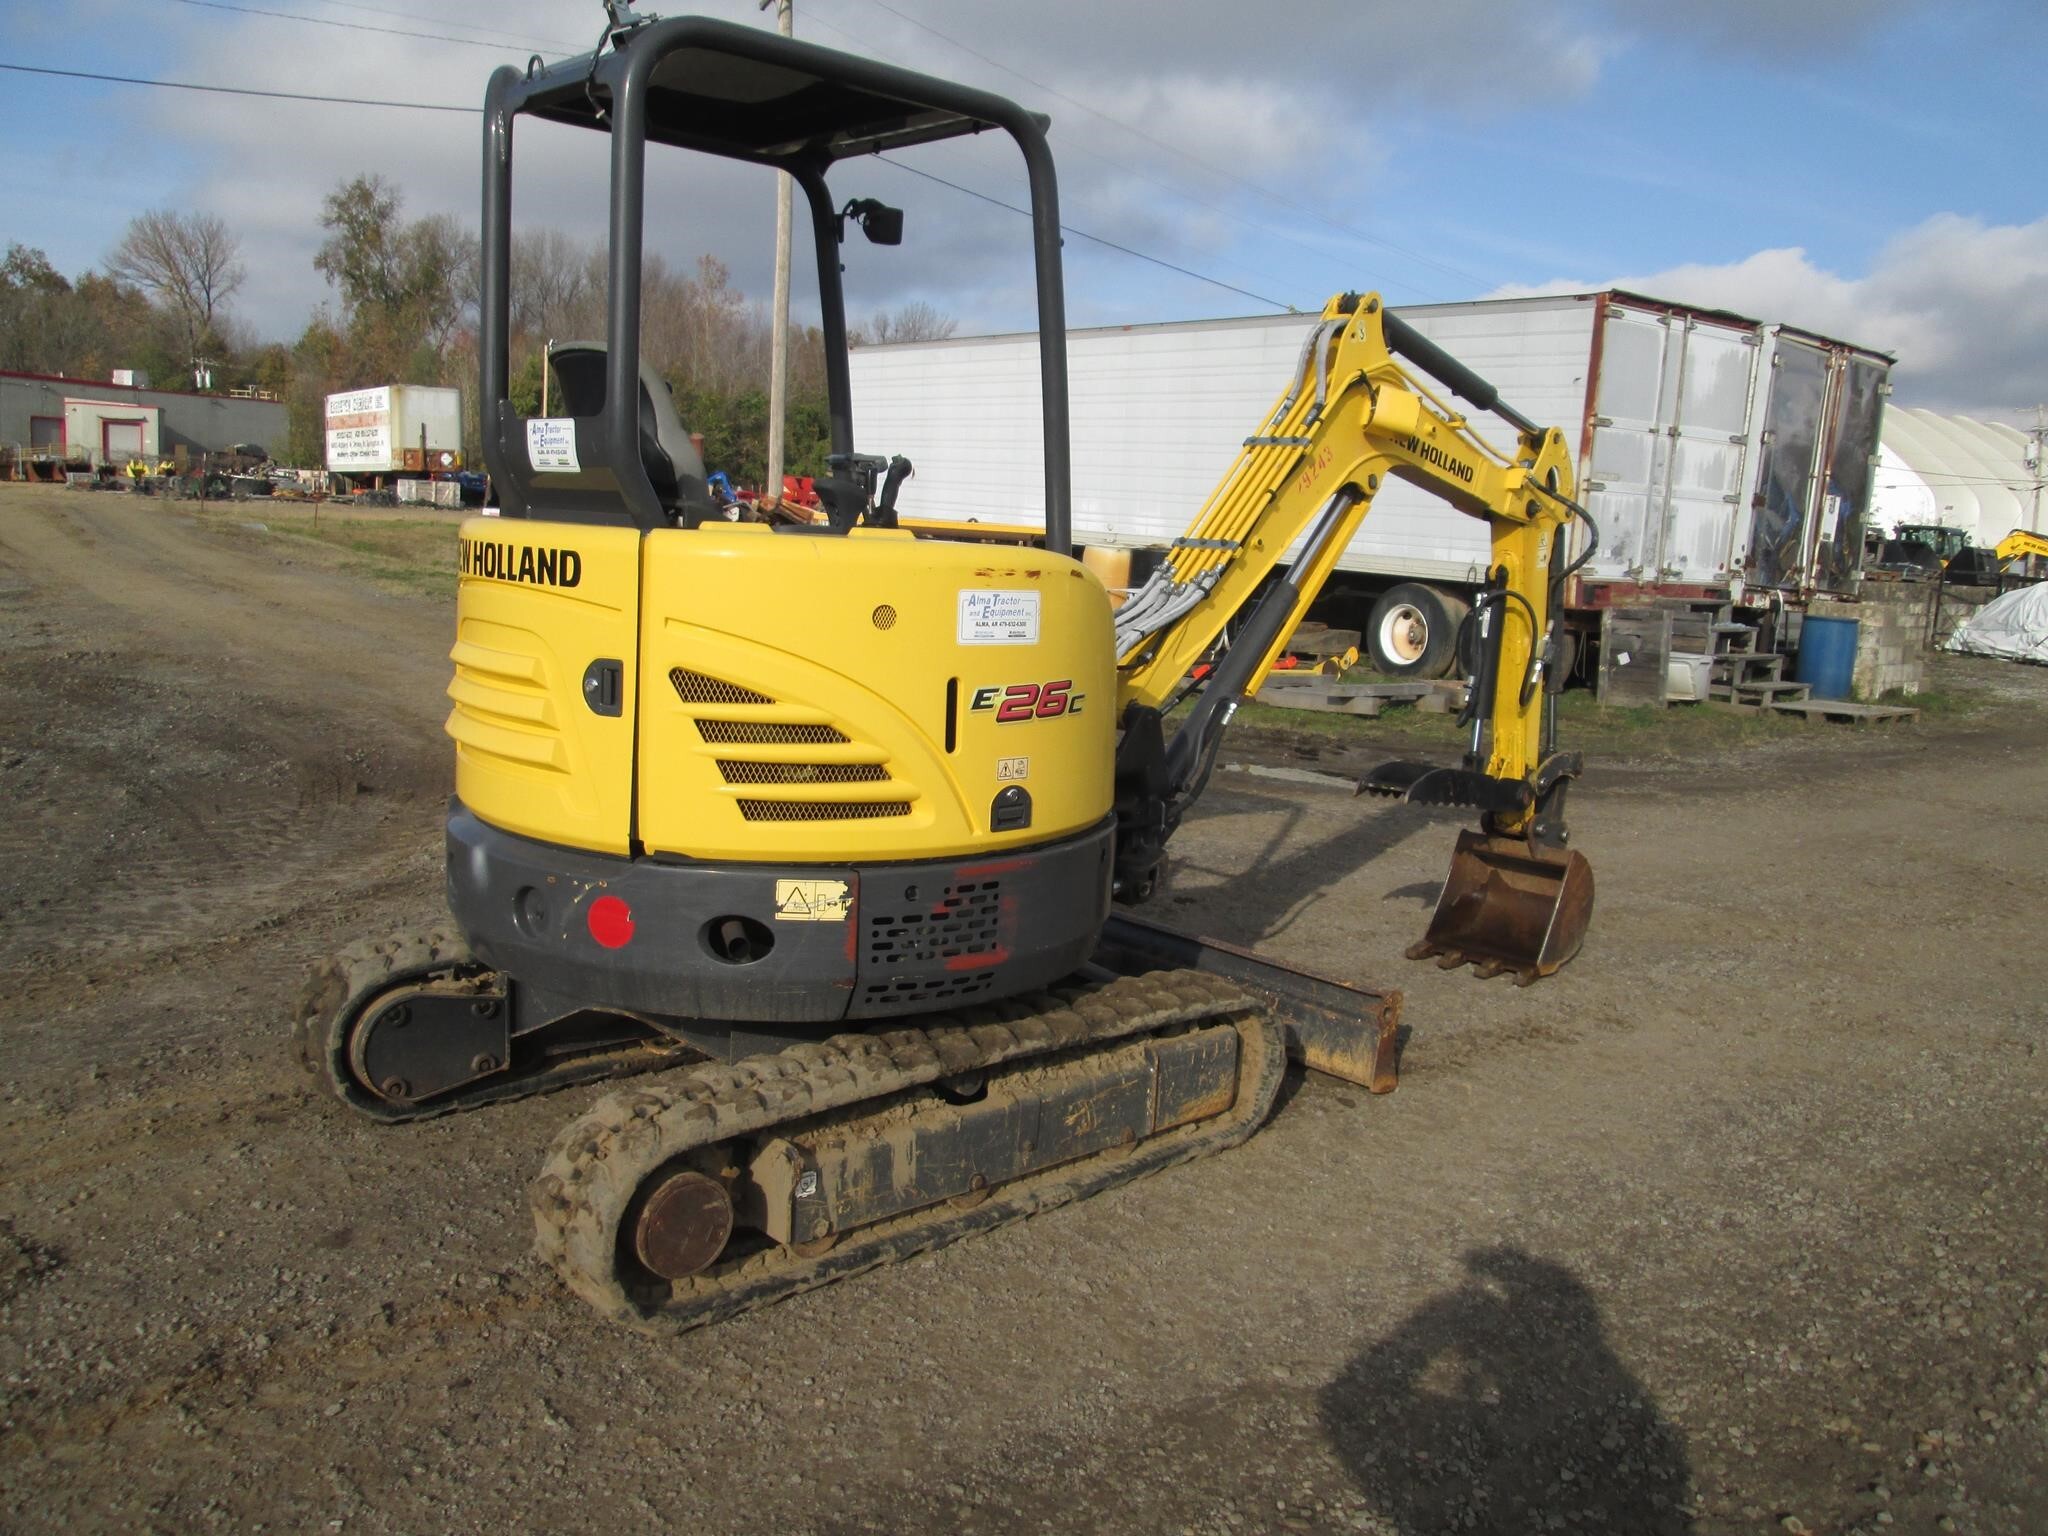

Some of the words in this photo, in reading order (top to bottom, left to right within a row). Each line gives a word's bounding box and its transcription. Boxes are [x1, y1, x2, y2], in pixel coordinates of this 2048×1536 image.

[1420, 441, 1474, 484] HOLLAND
[473, 540, 581, 588] HOLLAND
[968, 593, 991, 607] Alma
[993, 593, 1021, 607] Tractor
[982, 606, 1025, 619] Equipment
